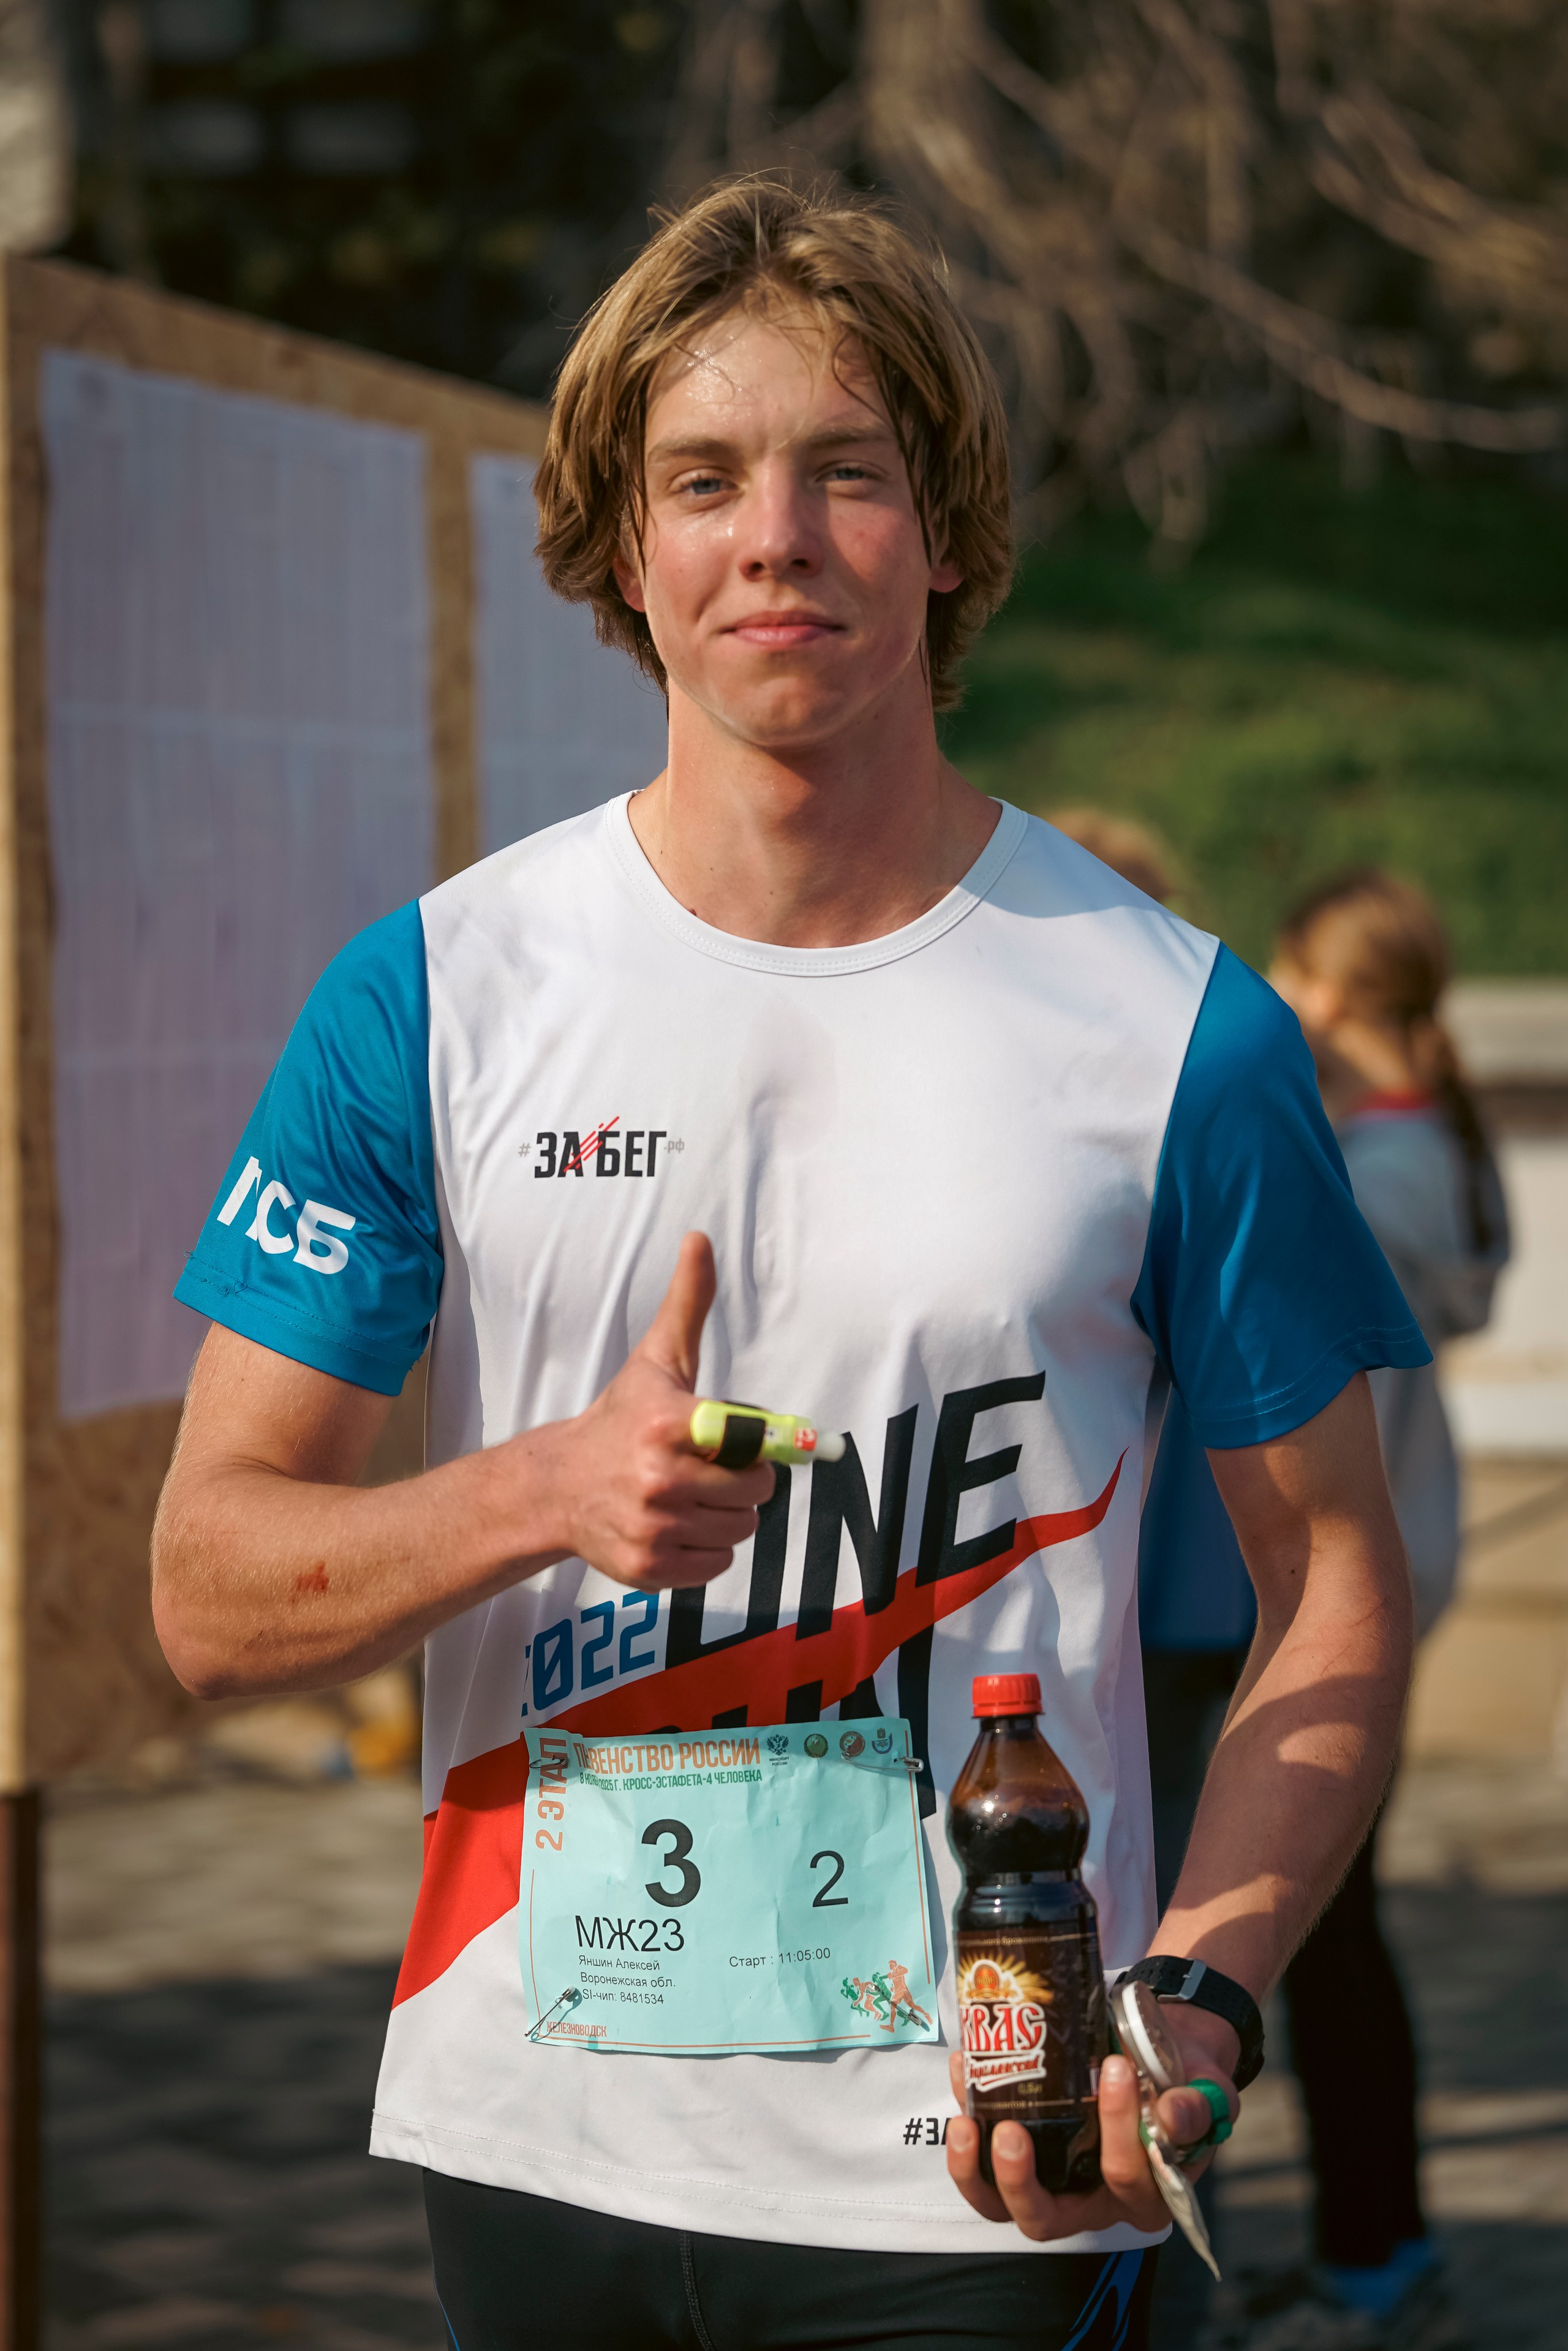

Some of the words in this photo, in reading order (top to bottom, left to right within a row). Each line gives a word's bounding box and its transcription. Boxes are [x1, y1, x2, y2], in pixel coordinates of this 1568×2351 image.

[521, 1589, 660, 1718] 022
[678, 1738, 761, 1769] РОССИИ
[538, 1737, 568, 1821] ЭТАП
[579, 1772, 584, 1784] 8
[598, 1778, 614, 1791] 2025
[614, 1779, 621, 1791] Г.
[623, 1773, 712, 1791] КРОСС-ЭСТАФЕТА-4
[714, 1769, 763, 1784] ЧЕЛОВЕКА
[535, 1829, 563, 1851] 2
[641, 1819, 701, 1908] 3
[810, 1850, 848, 1908] 2
[575, 1915, 685, 1952] МЖ23
[579, 1955, 613, 1968] Яншин
[616, 1958, 660, 1971] Алексей
[729, 1956, 766, 1968] Старт
[778, 1947, 831, 1964] 11:05:00
[581, 1972, 647, 1987] Воронежская
[650, 1976, 676, 1987] обл.
[582, 1988, 617, 2001] SI-чип:
[620, 1991, 664, 2004] 8481534
[546, 2020, 607, 2037] ЖЕЛЕЗНОВОДСК
